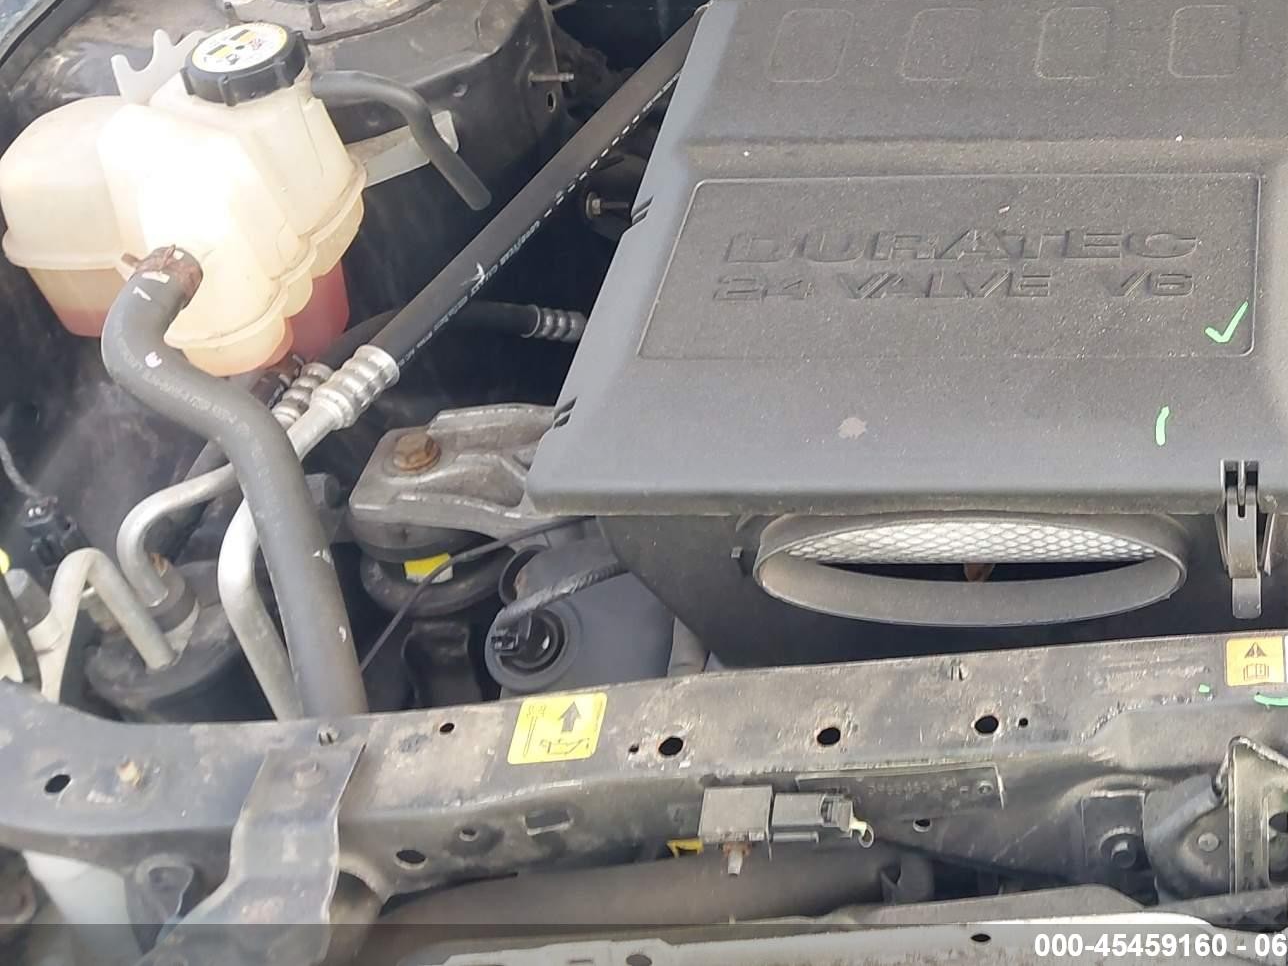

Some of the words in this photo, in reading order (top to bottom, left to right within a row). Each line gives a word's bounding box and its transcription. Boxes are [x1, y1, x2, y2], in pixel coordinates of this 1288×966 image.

[723, 229, 1199, 263] DURATEC
[712, 273, 816, 301] 24
[837, 270, 1052, 299] VALVE
[1104, 269, 1195, 298] V6
